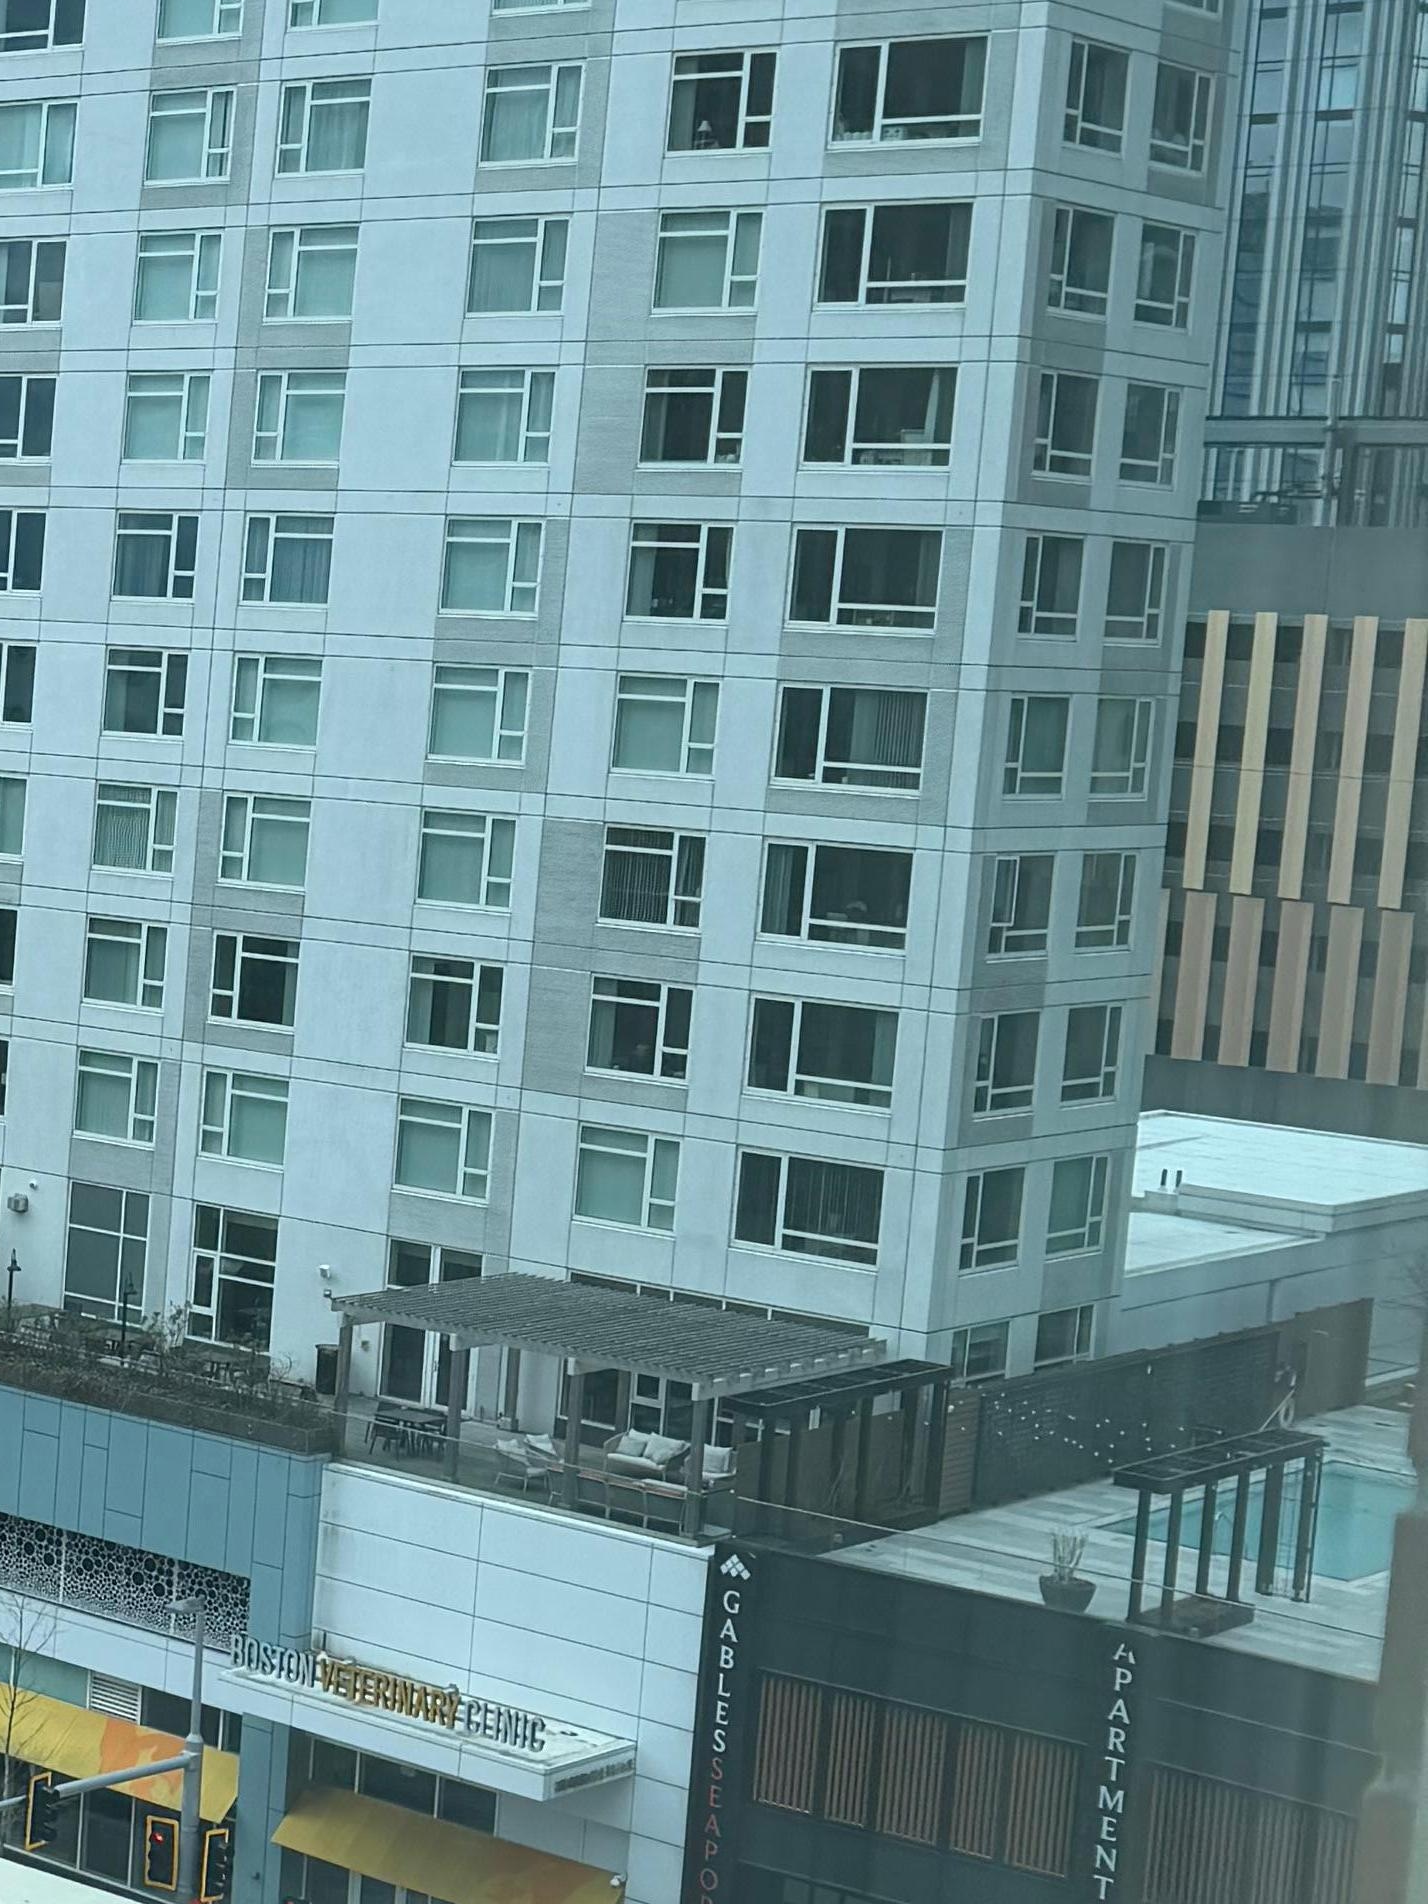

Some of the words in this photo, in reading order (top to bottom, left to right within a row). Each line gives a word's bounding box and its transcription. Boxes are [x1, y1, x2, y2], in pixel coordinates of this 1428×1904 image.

[231, 1633, 316, 1687] BOSTON
[319, 1658, 461, 1729] VETERINARY
[464, 1699, 546, 1753] CLINIC
[712, 1589, 741, 1753] GABLES
[1093, 1642, 1136, 1901] APARTMENT
